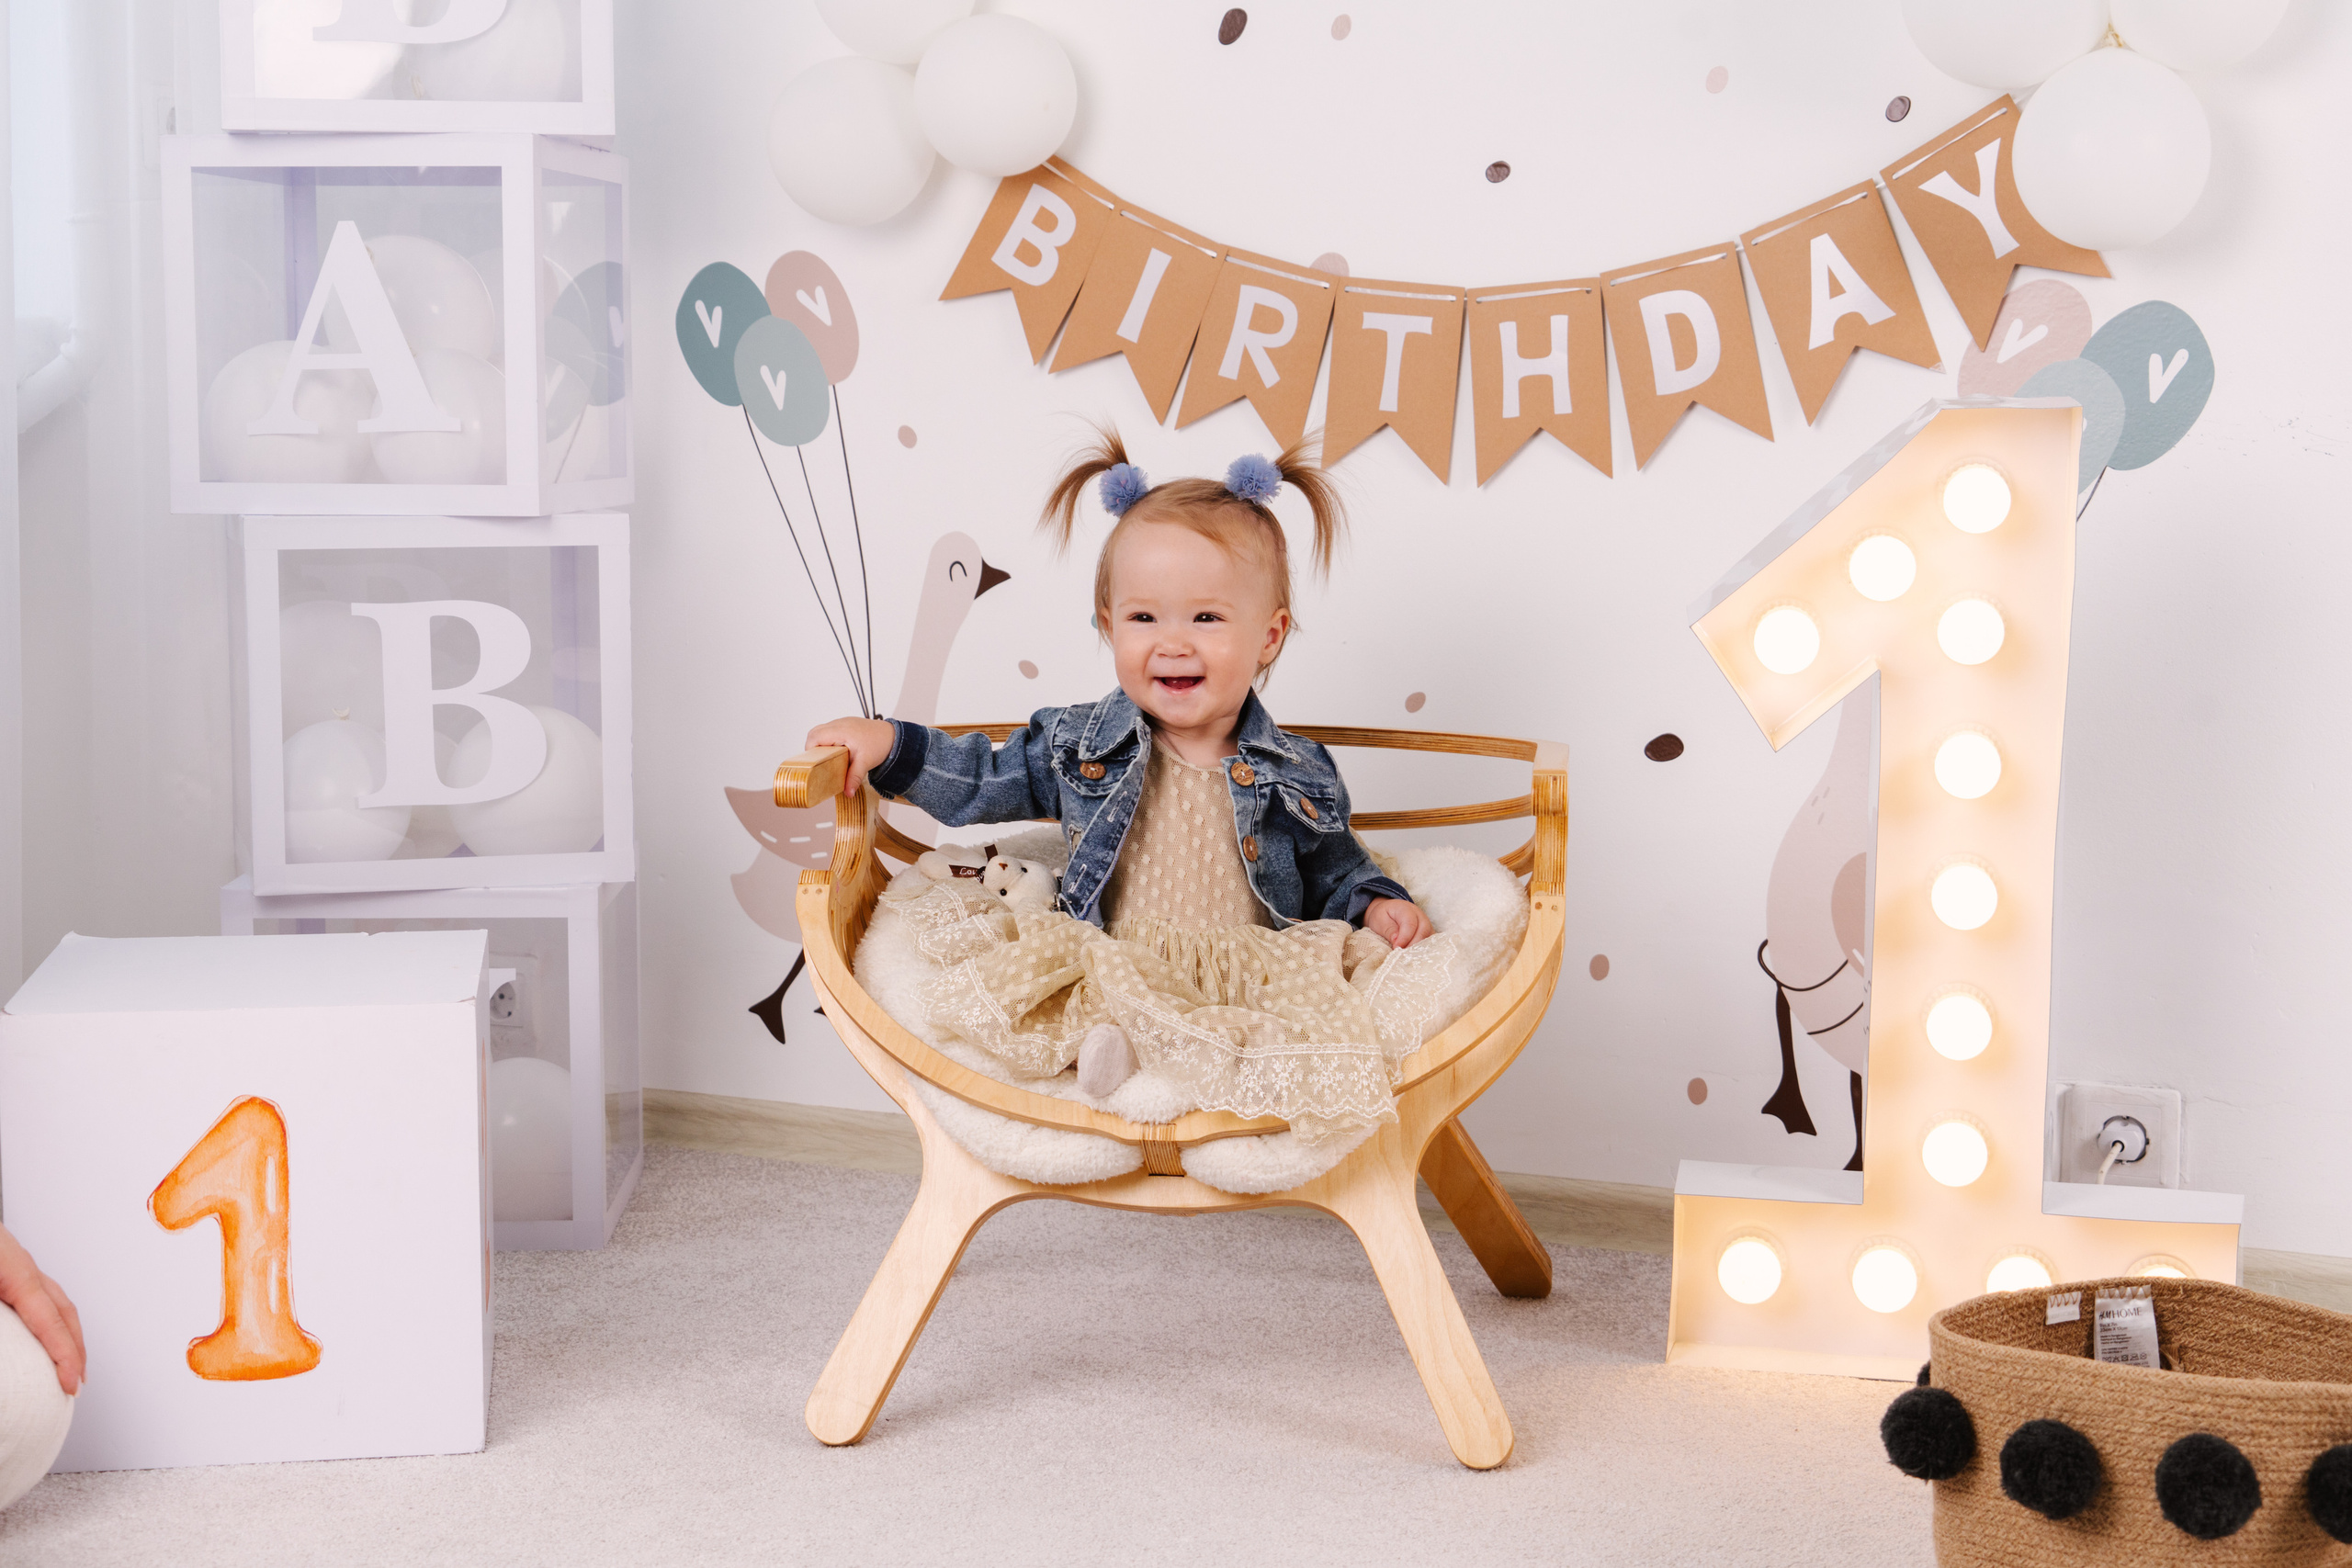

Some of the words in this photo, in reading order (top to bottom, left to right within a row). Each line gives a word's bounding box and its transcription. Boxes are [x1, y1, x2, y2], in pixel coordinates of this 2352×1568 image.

[247, 220, 461, 436] A
[991, 138, 2019, 419] BIRTHDAY
[351, 599, 547, 809] B
[147, 1095, 323, 1382] 1
[2112, 1307, 2143, 1319] HOME
